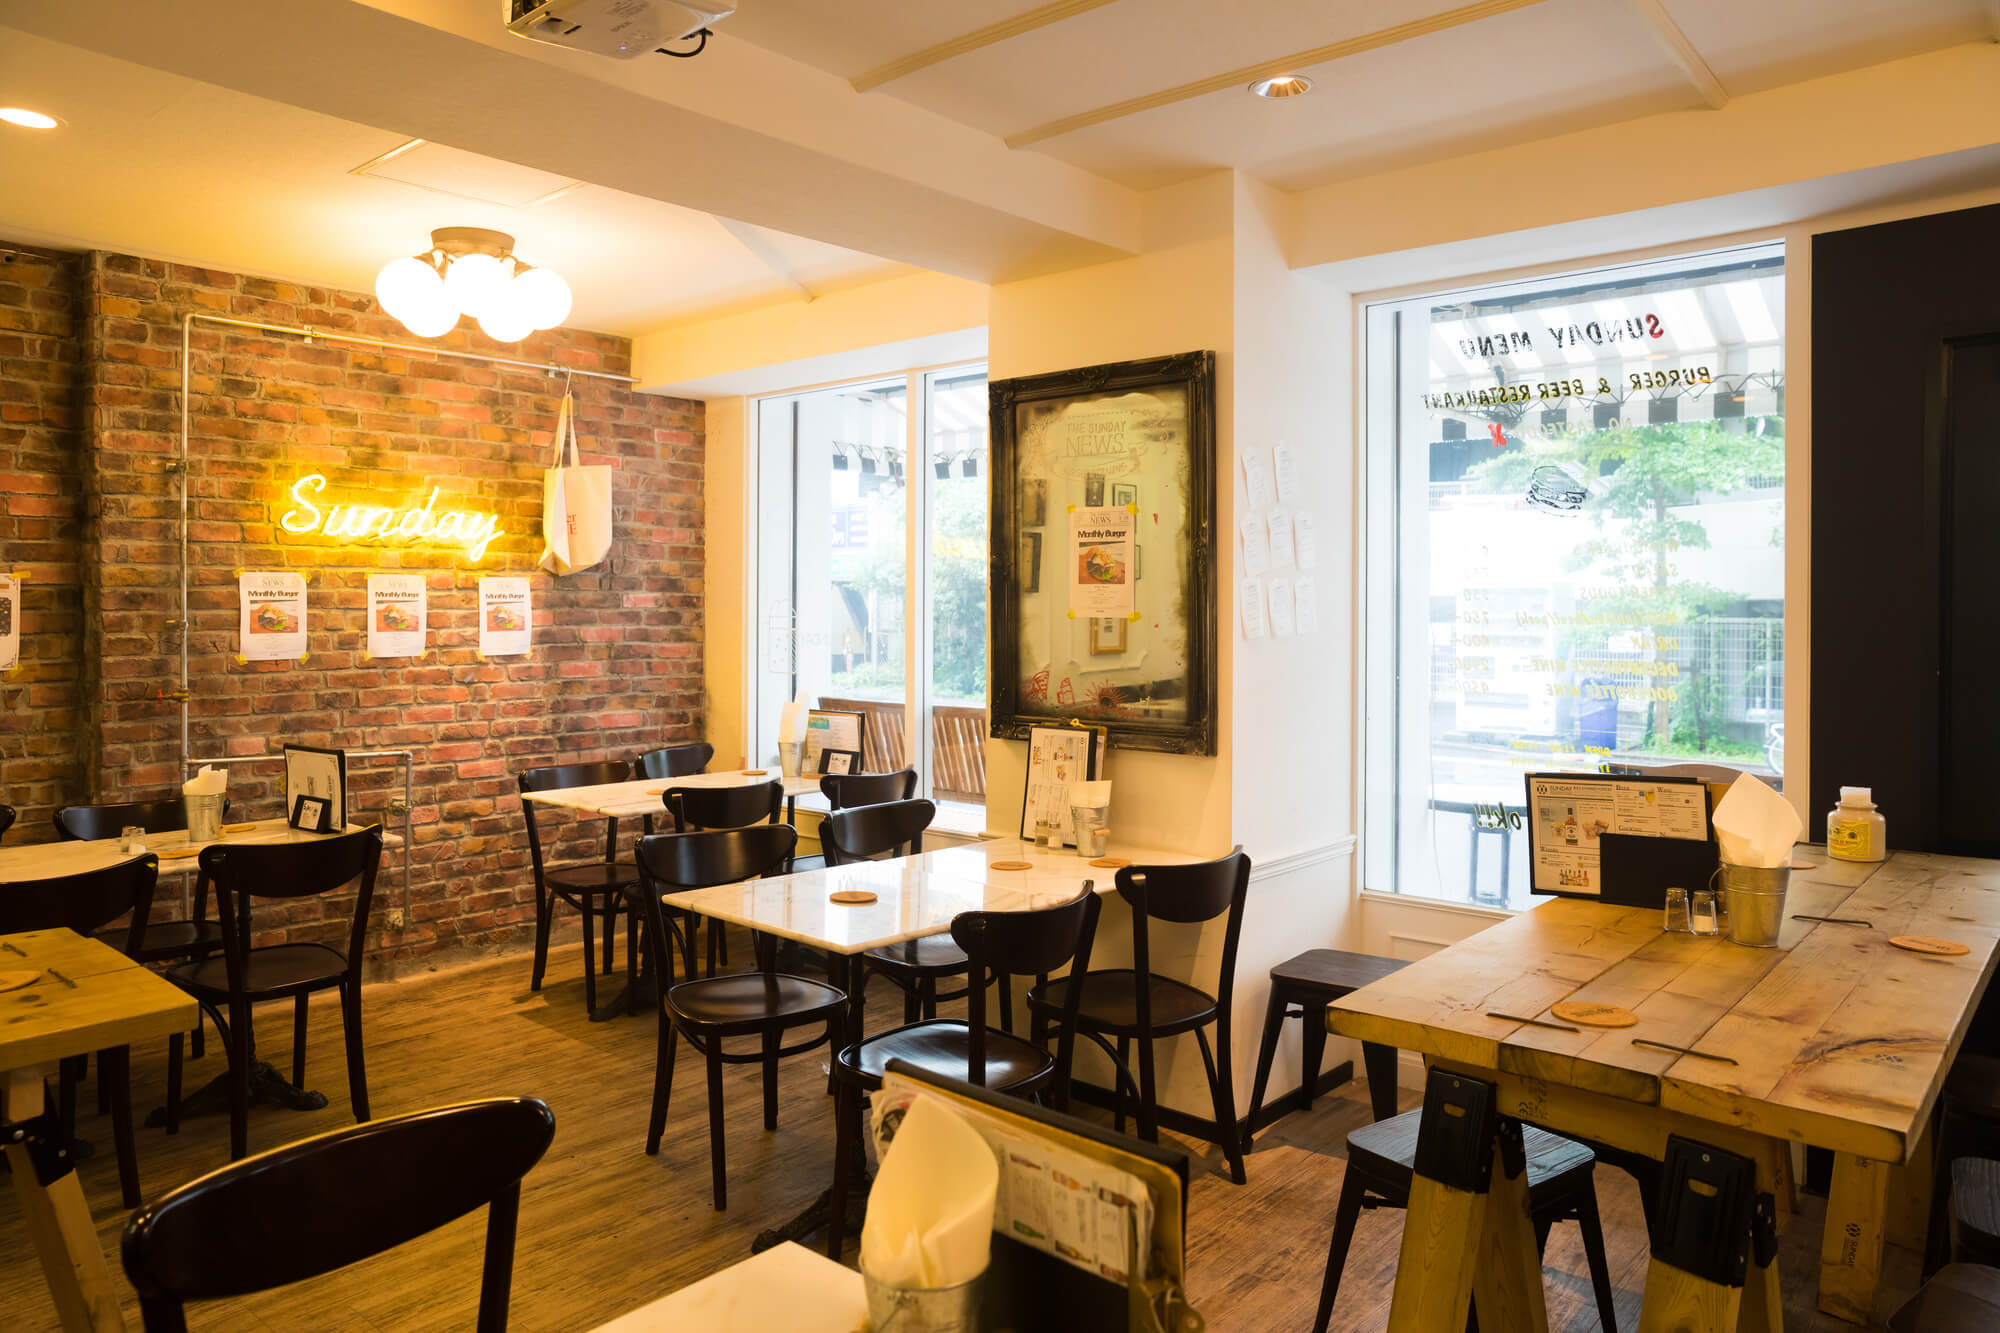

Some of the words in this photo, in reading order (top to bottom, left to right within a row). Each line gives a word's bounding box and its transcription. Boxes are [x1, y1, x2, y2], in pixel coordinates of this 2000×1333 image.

[1087, 421, 1126, 433] SUNDAY
[1066, 433, 1125, 456] NEWS
[281, 474, 504, 562] Sunday
[1077, 530, 1104, 539] Monthly
[1105, 530, 1127, 538] Burger
[248, 590, 277, 598] Monthly
[278, 590, 300, 598] Burger
